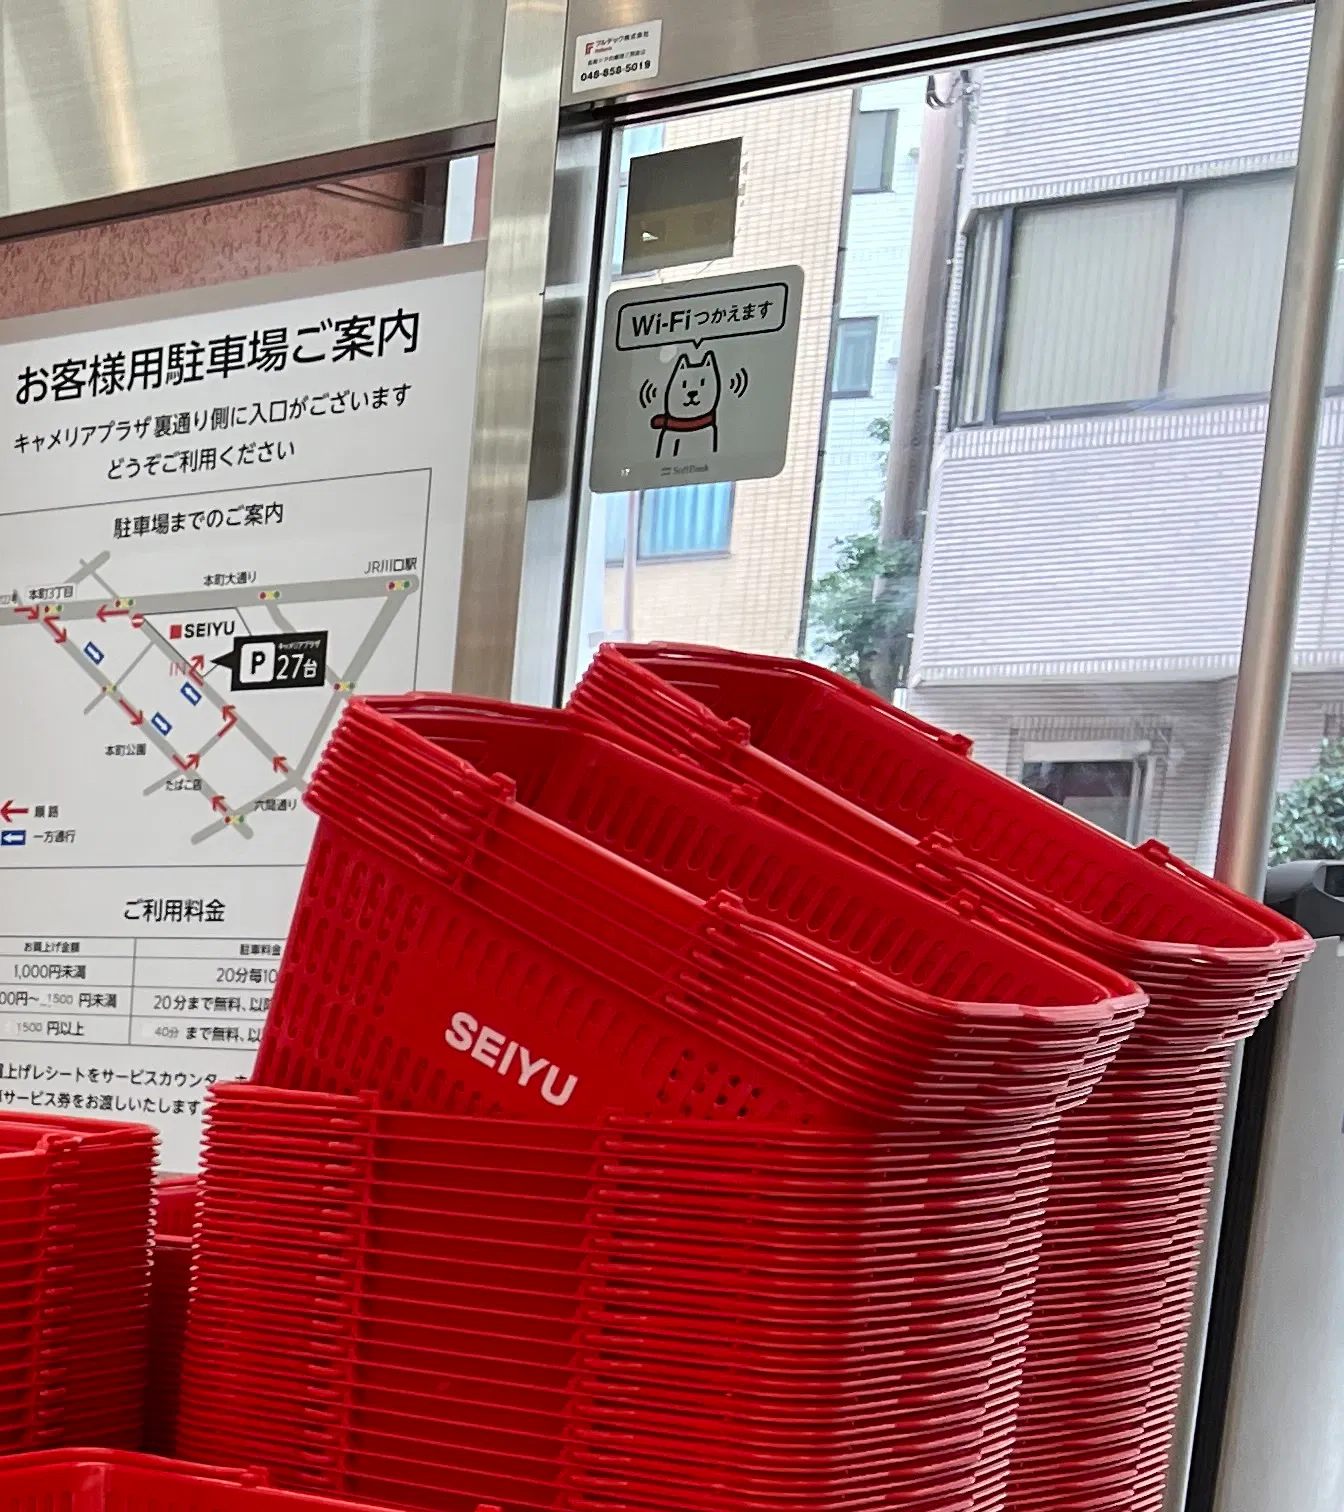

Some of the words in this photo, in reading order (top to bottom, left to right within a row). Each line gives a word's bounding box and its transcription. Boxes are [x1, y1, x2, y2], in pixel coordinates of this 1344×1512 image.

[14, 307, 421, 407] お客様用駐車場ご案内
[13, 383, 413, 454] キャメリアプラザ裏通り側に入口がございます
[105, 440, 297, 481] どうぞご利用ください
[112, 502, 284, 540] 駐車場までのご案内
[184, 621, 236, 638] SEIYU
[170, 662, 187, 675] IN
[251, 651, 267, 676] P
[276, 654, 317, 680] 27台
[123, 897, 226, 924] ご利用料金
[46, 1021, 85, 1036] 円以上
[444, 1010, 579, 1107] SEIYU
